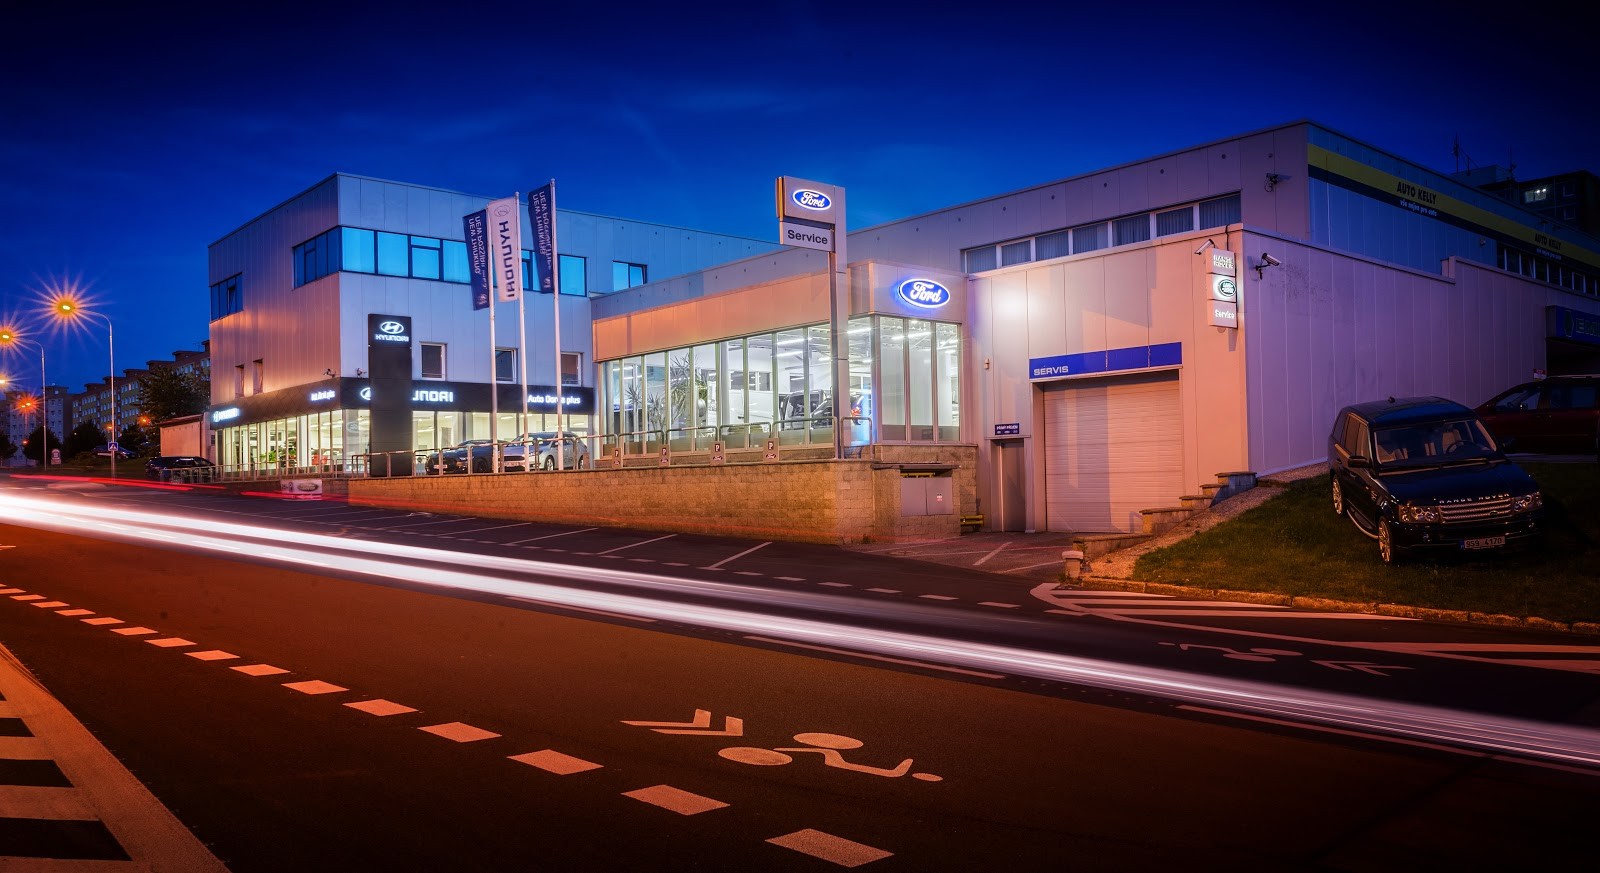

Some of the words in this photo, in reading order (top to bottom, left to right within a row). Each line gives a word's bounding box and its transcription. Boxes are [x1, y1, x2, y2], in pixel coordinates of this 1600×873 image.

[801, 191, 825, 207] Ford
[1397, 182, 1415, 197] AUTO
[1418, 189, 1436, 204] KELLY
[788, 230, 828, 244] Service
[910, 281, 941, 302] Ford
[375, 334, 409, 342] HYUNDAI
[1033, 365, 1069, 376] SERVIS
[528, 395, 544, 403] Auto
[567, 396, 580, 405] plus
